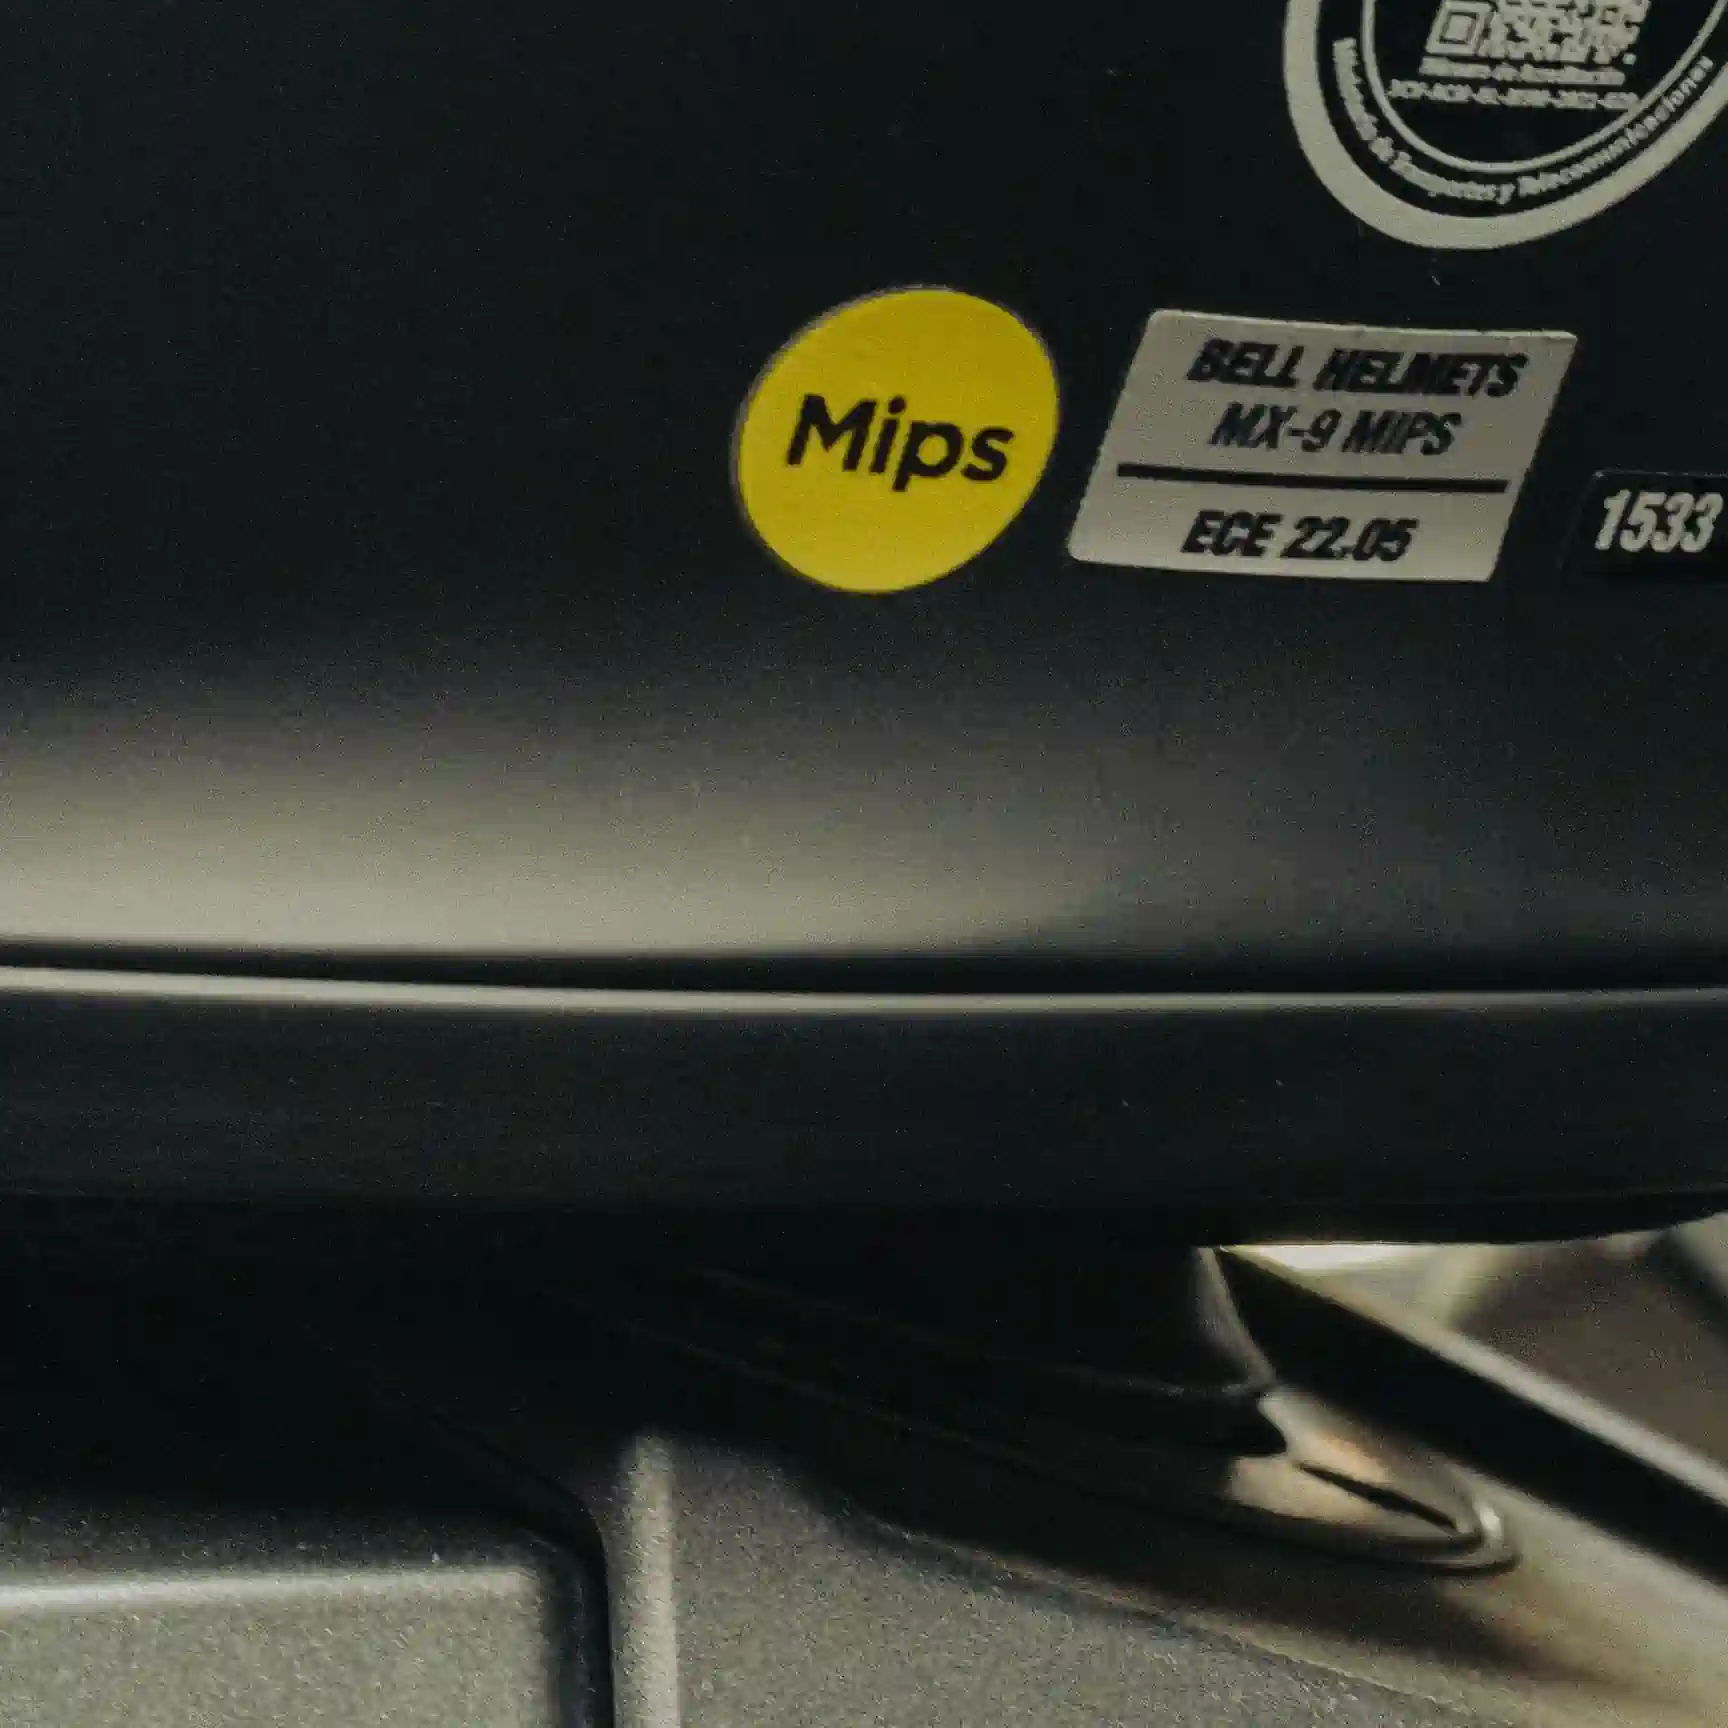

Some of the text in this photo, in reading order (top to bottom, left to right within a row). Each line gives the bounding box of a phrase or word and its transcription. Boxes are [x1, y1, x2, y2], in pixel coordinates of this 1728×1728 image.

[1186, 337, 1530, 398] BELL HELMETS
[786, 393, 1015, 493] Mips
[1210, 400, 1463, 456] MX-9 MIPS
[1180, 510, 1421, 562] ECE 22.05
[1594, 489, 1724, 553] 1533
